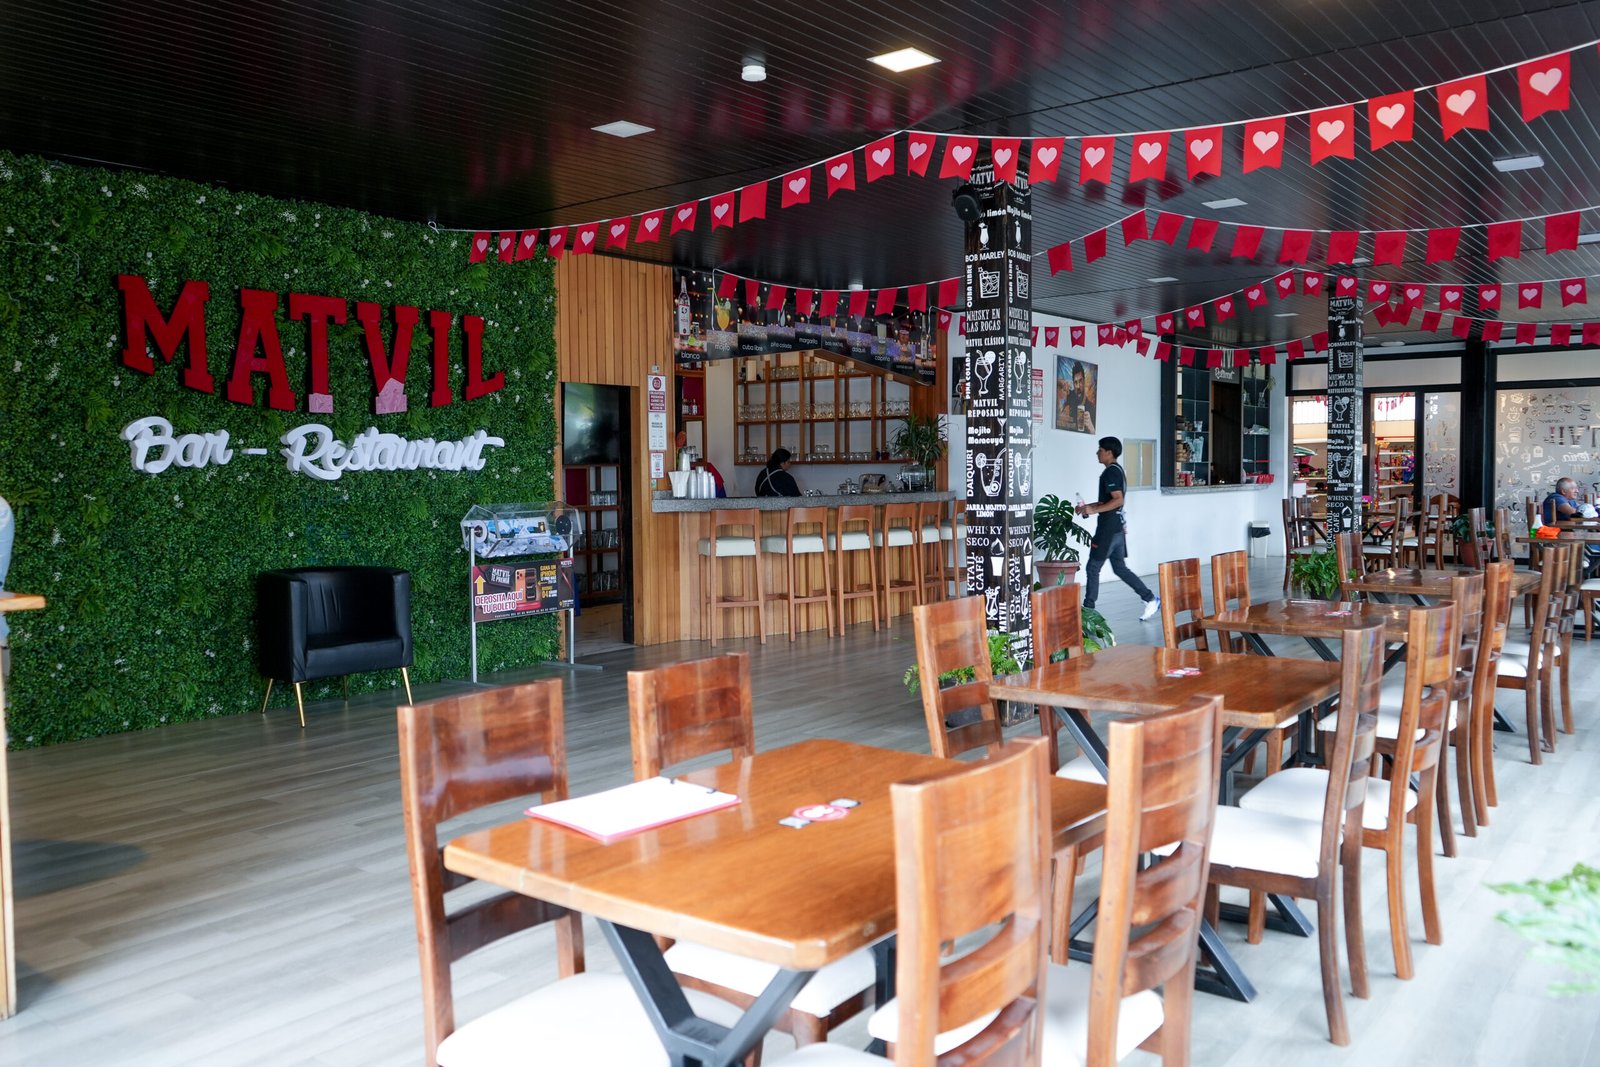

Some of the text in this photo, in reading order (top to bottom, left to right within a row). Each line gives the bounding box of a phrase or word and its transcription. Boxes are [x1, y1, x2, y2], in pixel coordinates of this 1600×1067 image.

[968, 170, 995, 185] MATVI
[965, 250, 1005, 263] BOB MARLEY
[966, 321, 979, 333] LAS
[118, 272, 504, 415] MATVIL
[973, 398, 998, 407] MATVIL
[967, 408, 1005, 418] REPOSADO
[967, 426, 991, 436] Mojito
[121, 416, 234, 474] Bar
[281, 424, 505, 481] Restaurant
[966, 449, 975, 497] DAIQUIRI
[1008, 525, 1031, 535] WHISKY
[966, 537, 990, 547] SECO
[1008, 537, 1024, 548] SECO
[475, 592, 506, 606] DEPOSITA
[482, 601, 517, 614] TU BOLETO
[998, 601, 1007, 633] MATVIL
